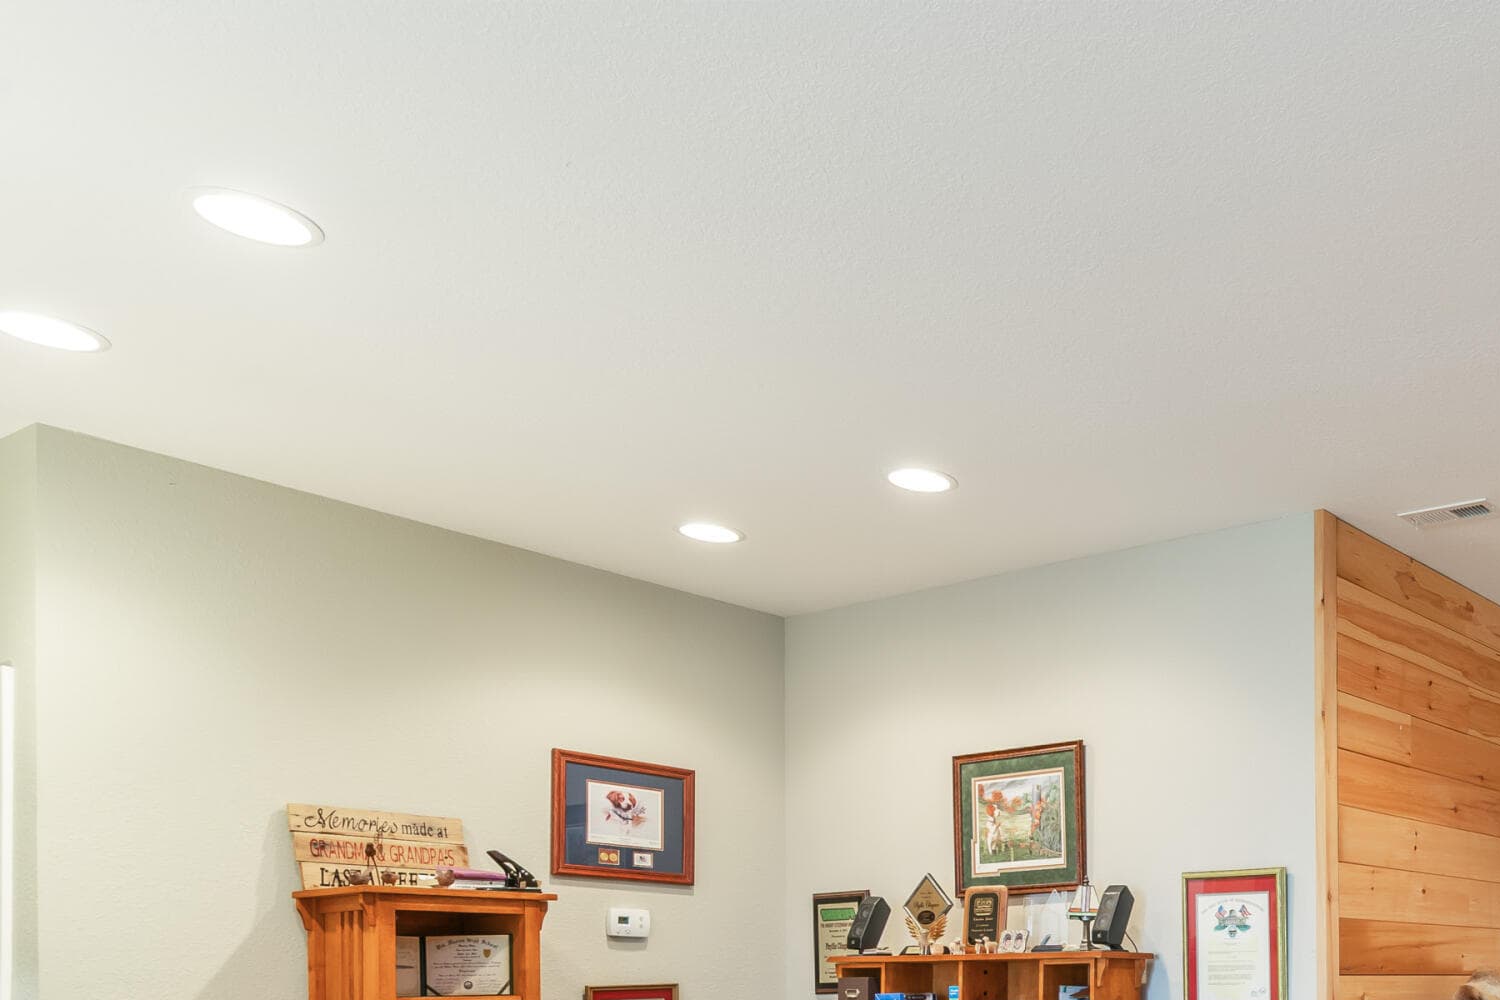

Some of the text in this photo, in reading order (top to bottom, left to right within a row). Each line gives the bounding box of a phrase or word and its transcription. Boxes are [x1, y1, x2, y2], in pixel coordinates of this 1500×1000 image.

[304, 808, 449, 839] Memories made at
[389, 844, 455, 867] GRANDPA'S
